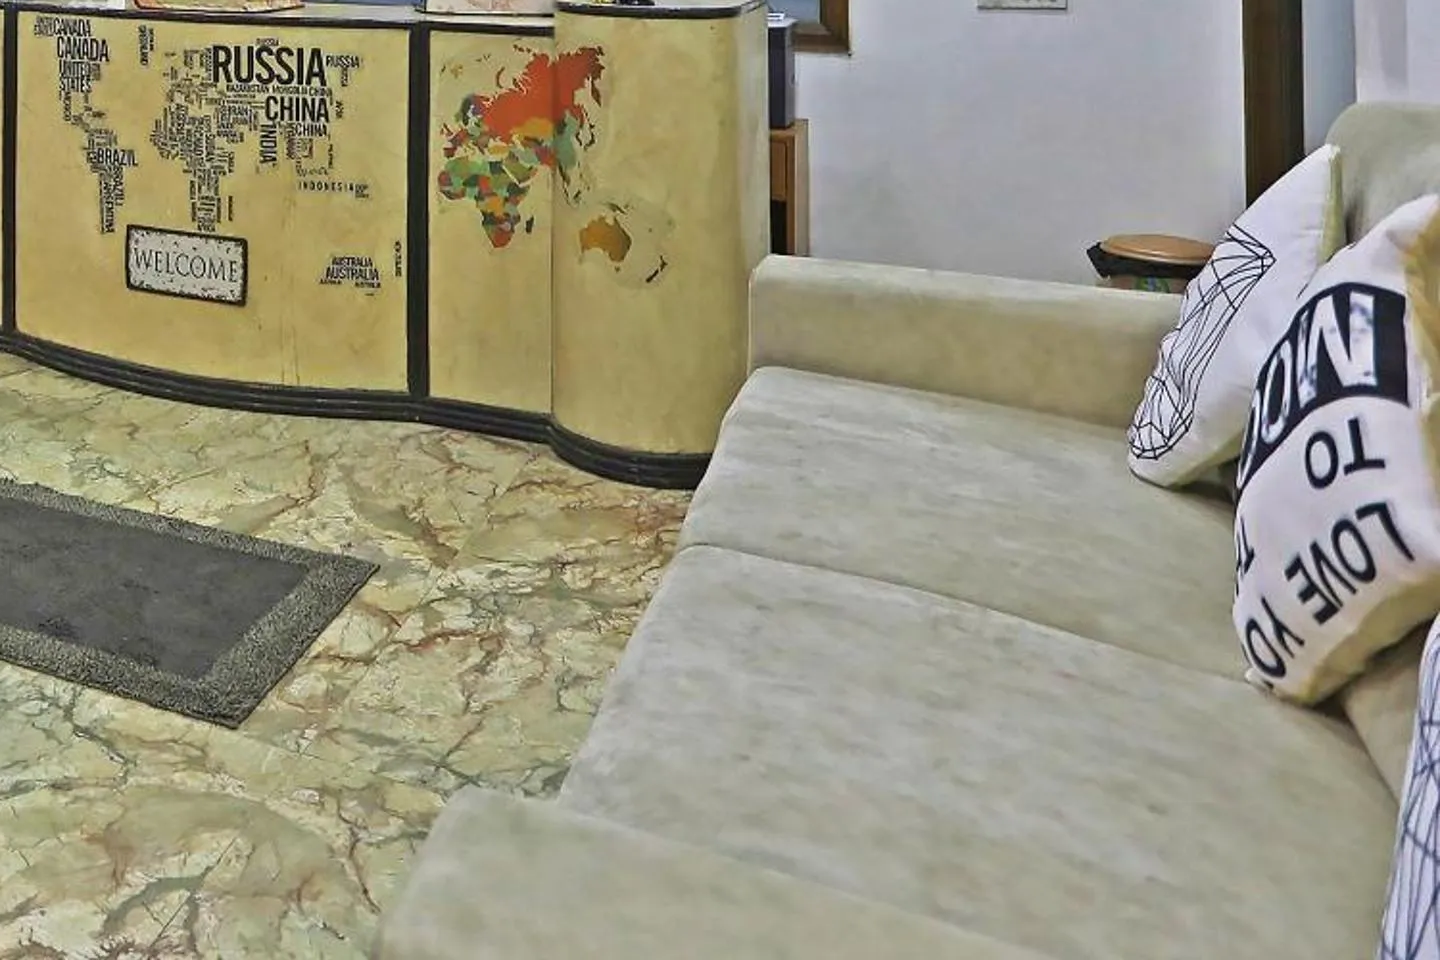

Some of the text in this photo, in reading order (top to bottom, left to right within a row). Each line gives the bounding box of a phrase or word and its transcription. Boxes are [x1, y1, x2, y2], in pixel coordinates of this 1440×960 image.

[54, 17, 92, 37] CANADA
[57, 36, 110, 62] CANADA
[59, 60, 91, 80] UNITED
[212, 45, 327, 87] RUSSIA
[326, 55, 360, 68] RUSSIA
[59, 78, 92, 93] STATES
[265, 95, 329, 123] CHINA
[295, 123, 328, 137] CHINA
[259, 123, 277, 164] INDIA
[97, 148, 138, 166] BRAZIL
[299, 181, 354, 192] INDONESIA
[134, 247, 237, 283] WELCOME
[332, 256, 373, 267] AUSTRALIA
[326, 266, 379, 281] AUSTRALIA
[1237, 290, 1378, 488] MOO
[1305, 417, 1386, 489] TO
[1245, 502, 1415, 688] LOVE YO
